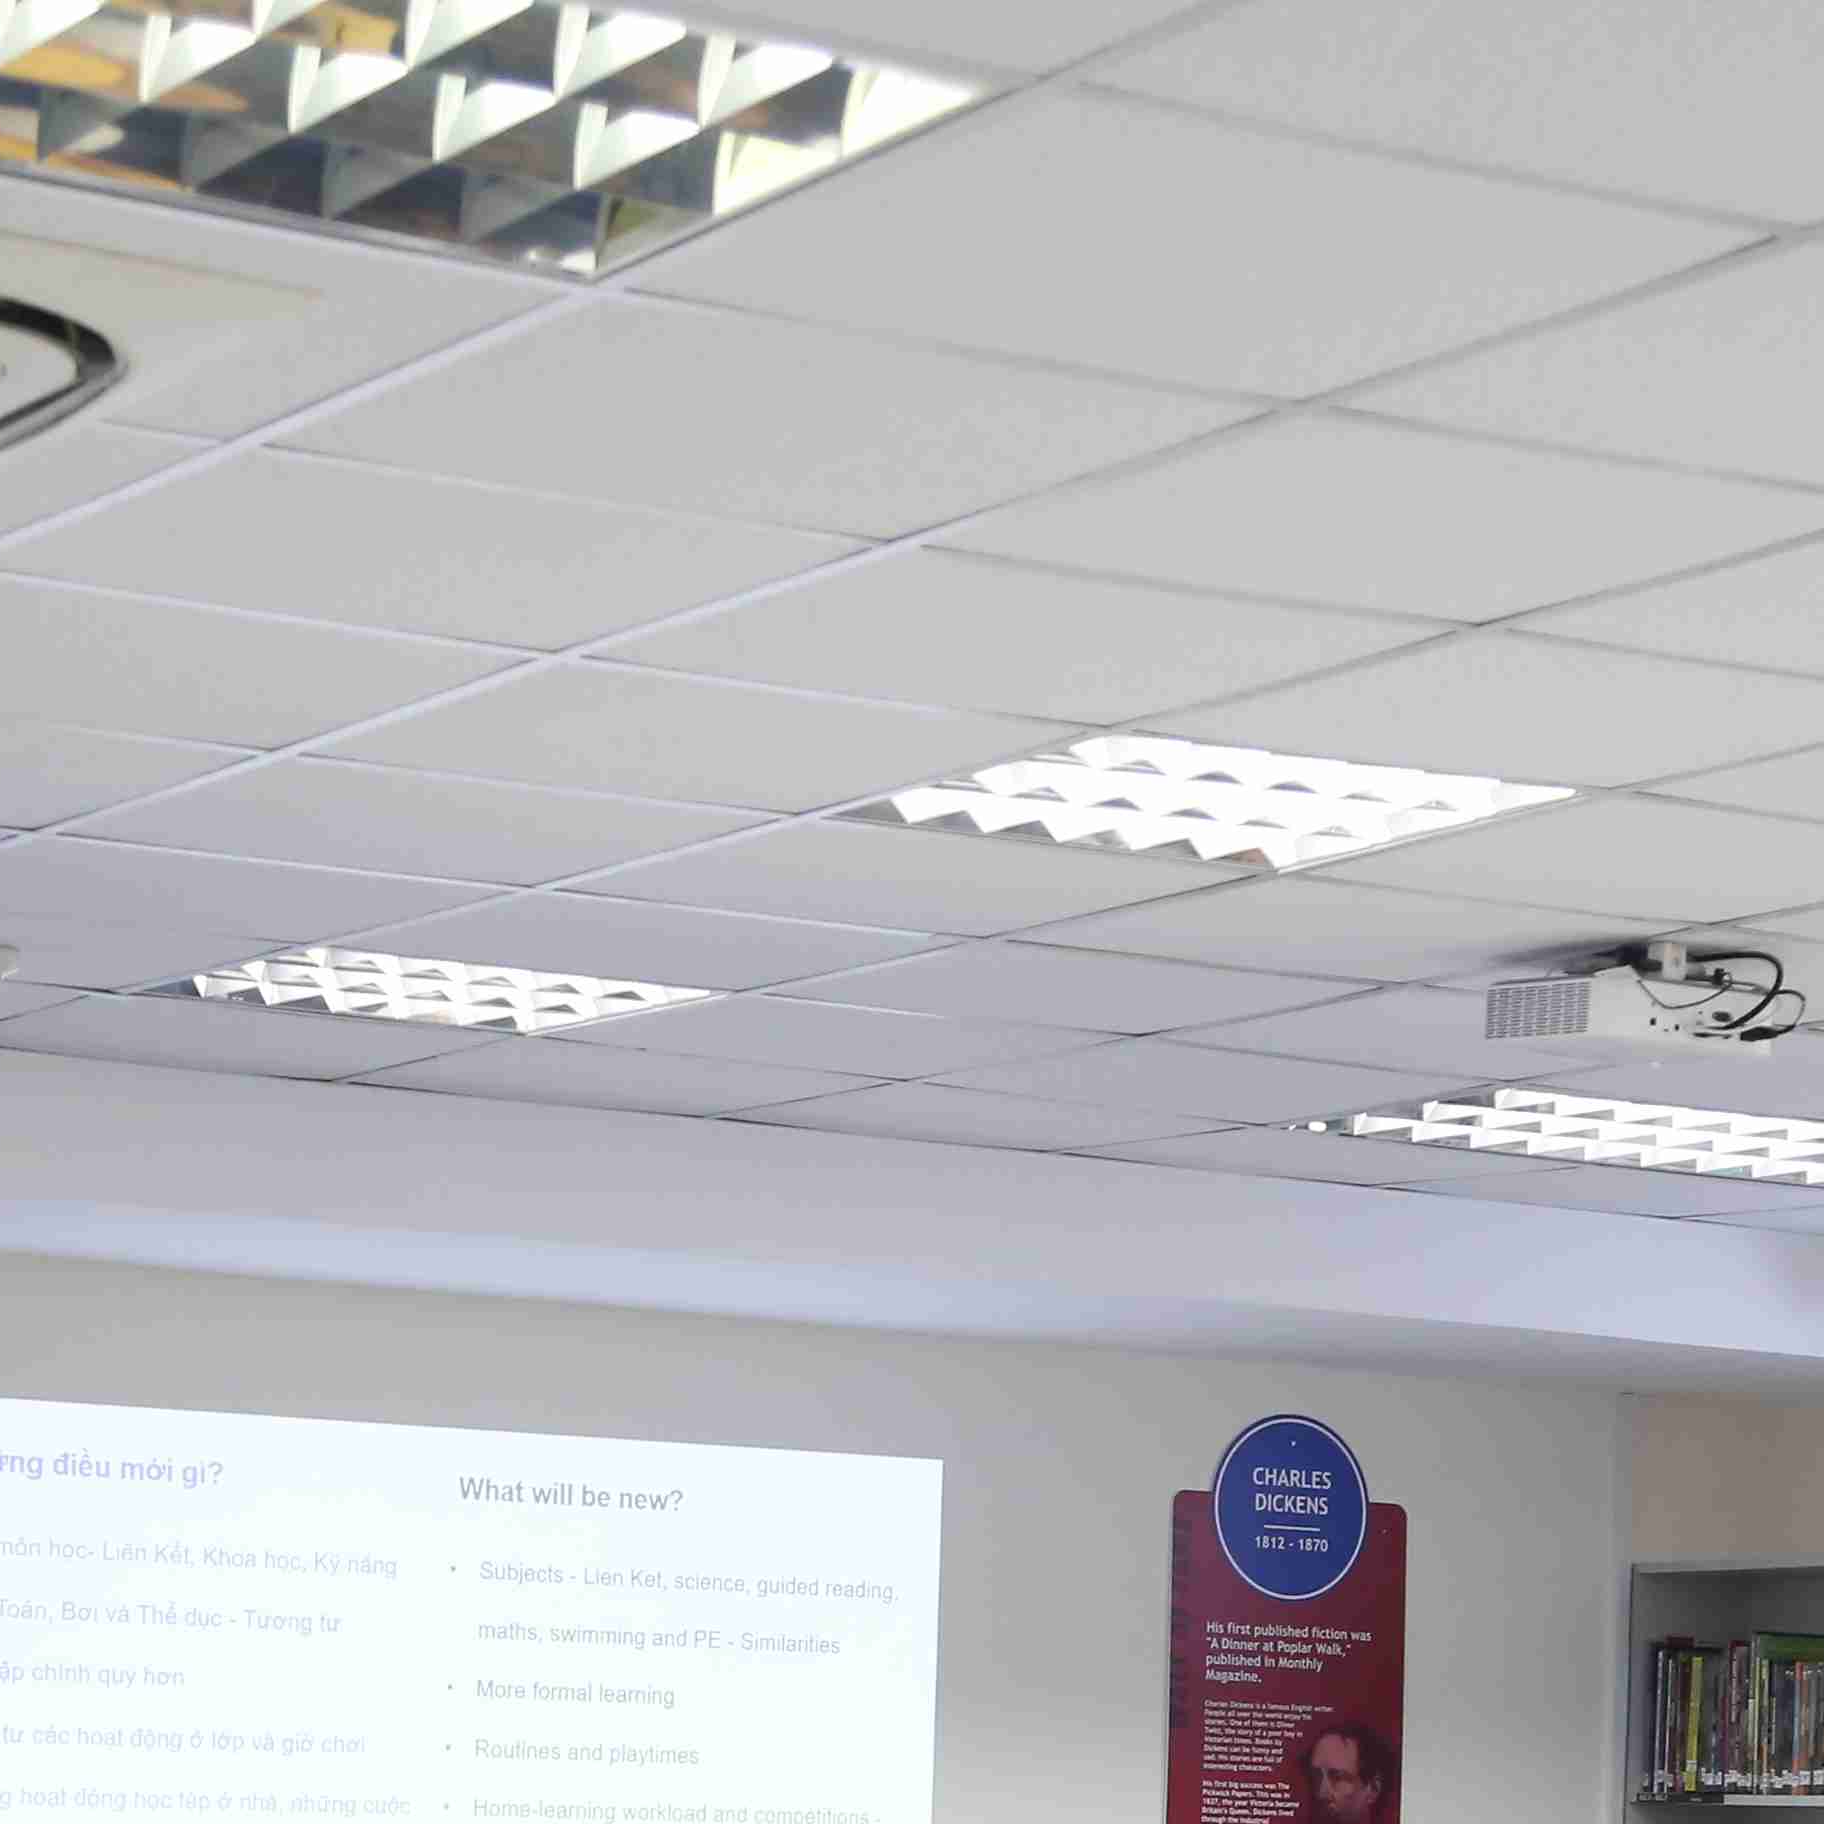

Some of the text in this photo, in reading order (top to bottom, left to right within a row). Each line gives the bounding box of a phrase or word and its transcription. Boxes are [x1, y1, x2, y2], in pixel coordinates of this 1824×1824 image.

[53, 1449, 111, 1480] điều
[120, 1458, 174, 1483] mới
[182, 1462, 224, 1488] gì?
[1253, 1467, 1331, 1489] CHARLES
[459, 1477, 684, 1511] What will be new?
[1255, 1493, 1329, 1515] DICKENS
[1255, 1536, 1329, 1552] 1812 1870
[203, 1546, 257, 1569] Khoa
[479, 1562, 564, 1587] Subjects
[674, 1573, 751, 1595] science,
[757, 1576, 819, 1598] guided
[478, 1623, 840, 1654] maths, swimming and PE Similarities
[1206, 1622, 1372, 1641] His first published fiction was
[1222, 1638, 1259, 1651] Dinner
[1263, 1641, 1274, 1652] at
[1278, 1641, 1313, 1655] Poplar
[1206, 1654, 1323, 1672] published in Monthly
[1206, 1670, 1263, 1684] Magazine.
[476, 1680, 675, 1709] More formal learning
[474, 1739, 699, 1767] Routines and playtimes
[473, 1800, 616, 1824] Home-learning
[622, 1802, 706, 1824] workload
[713, 1806, 747, 1824] and
